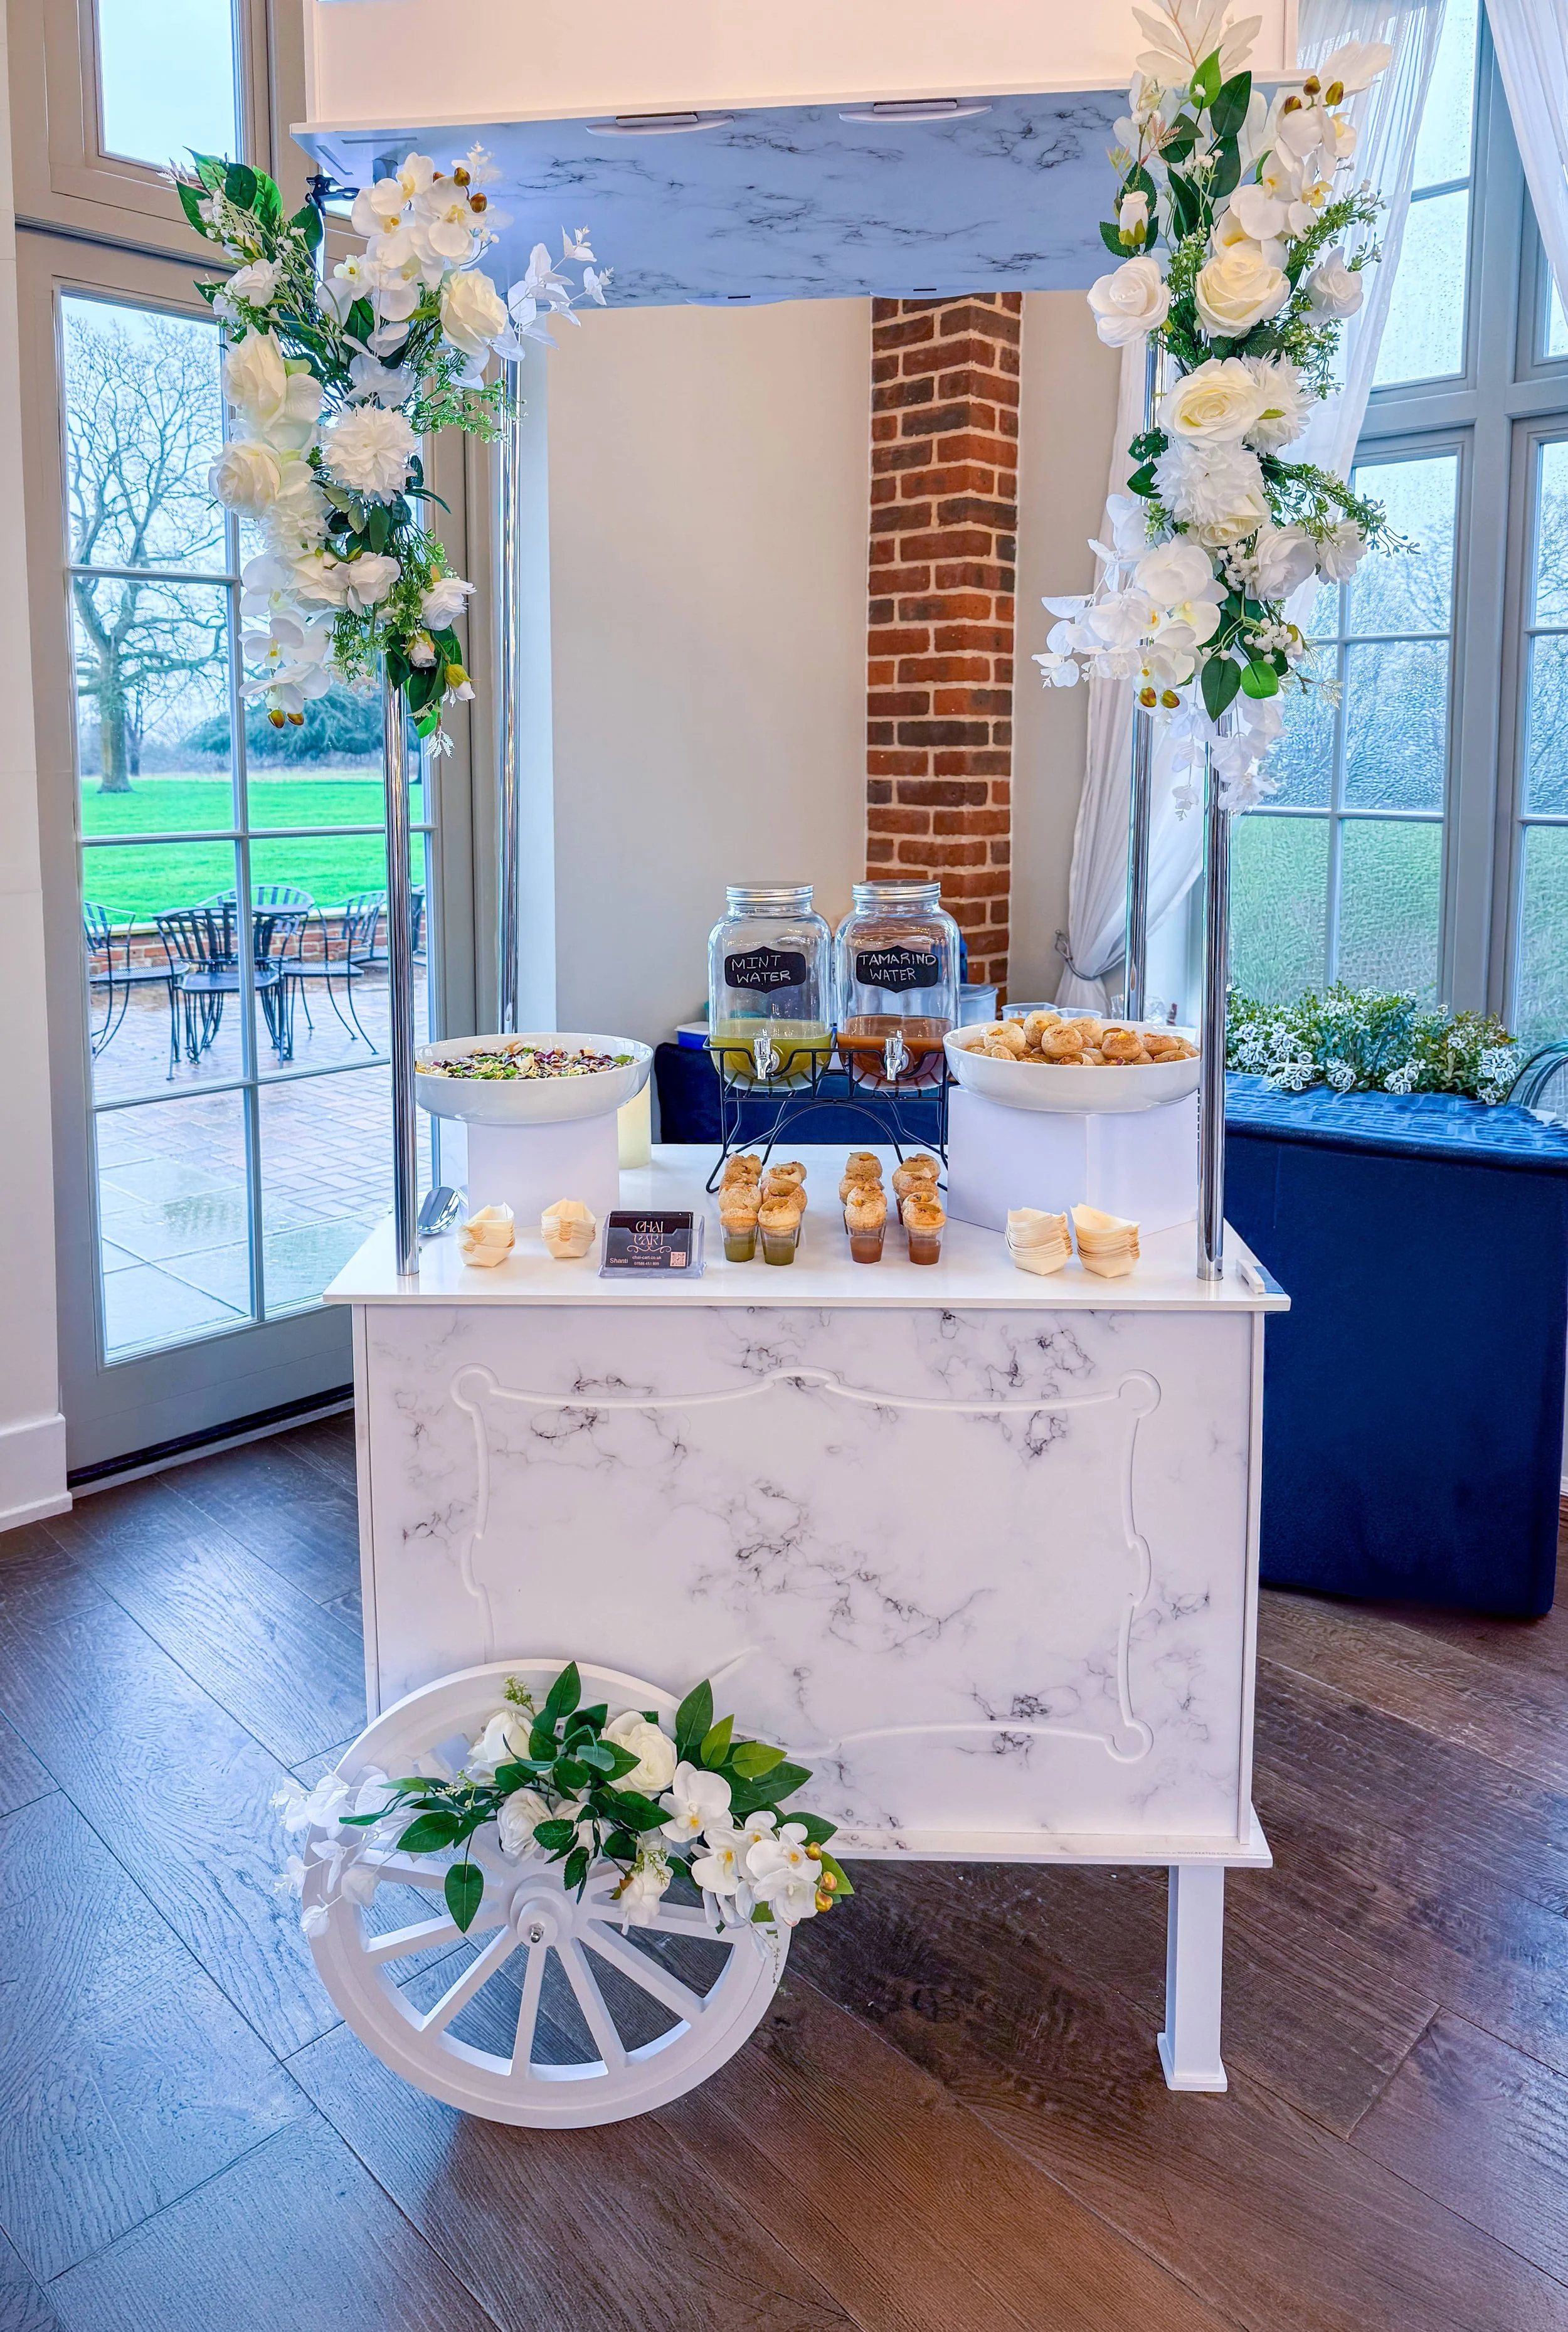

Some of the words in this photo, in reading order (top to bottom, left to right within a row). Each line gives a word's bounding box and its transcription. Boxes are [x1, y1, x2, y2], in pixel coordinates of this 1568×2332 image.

[731, 955, 781, 972] MINT
[858, 952, 937, 967] TAMARIND
[736, 970, 792, 984] WATER
[869, 967, 916, 982] WATER
[635, 1221, 664, 1233] CHAI
[633, 1234, 663, 1245] CART
